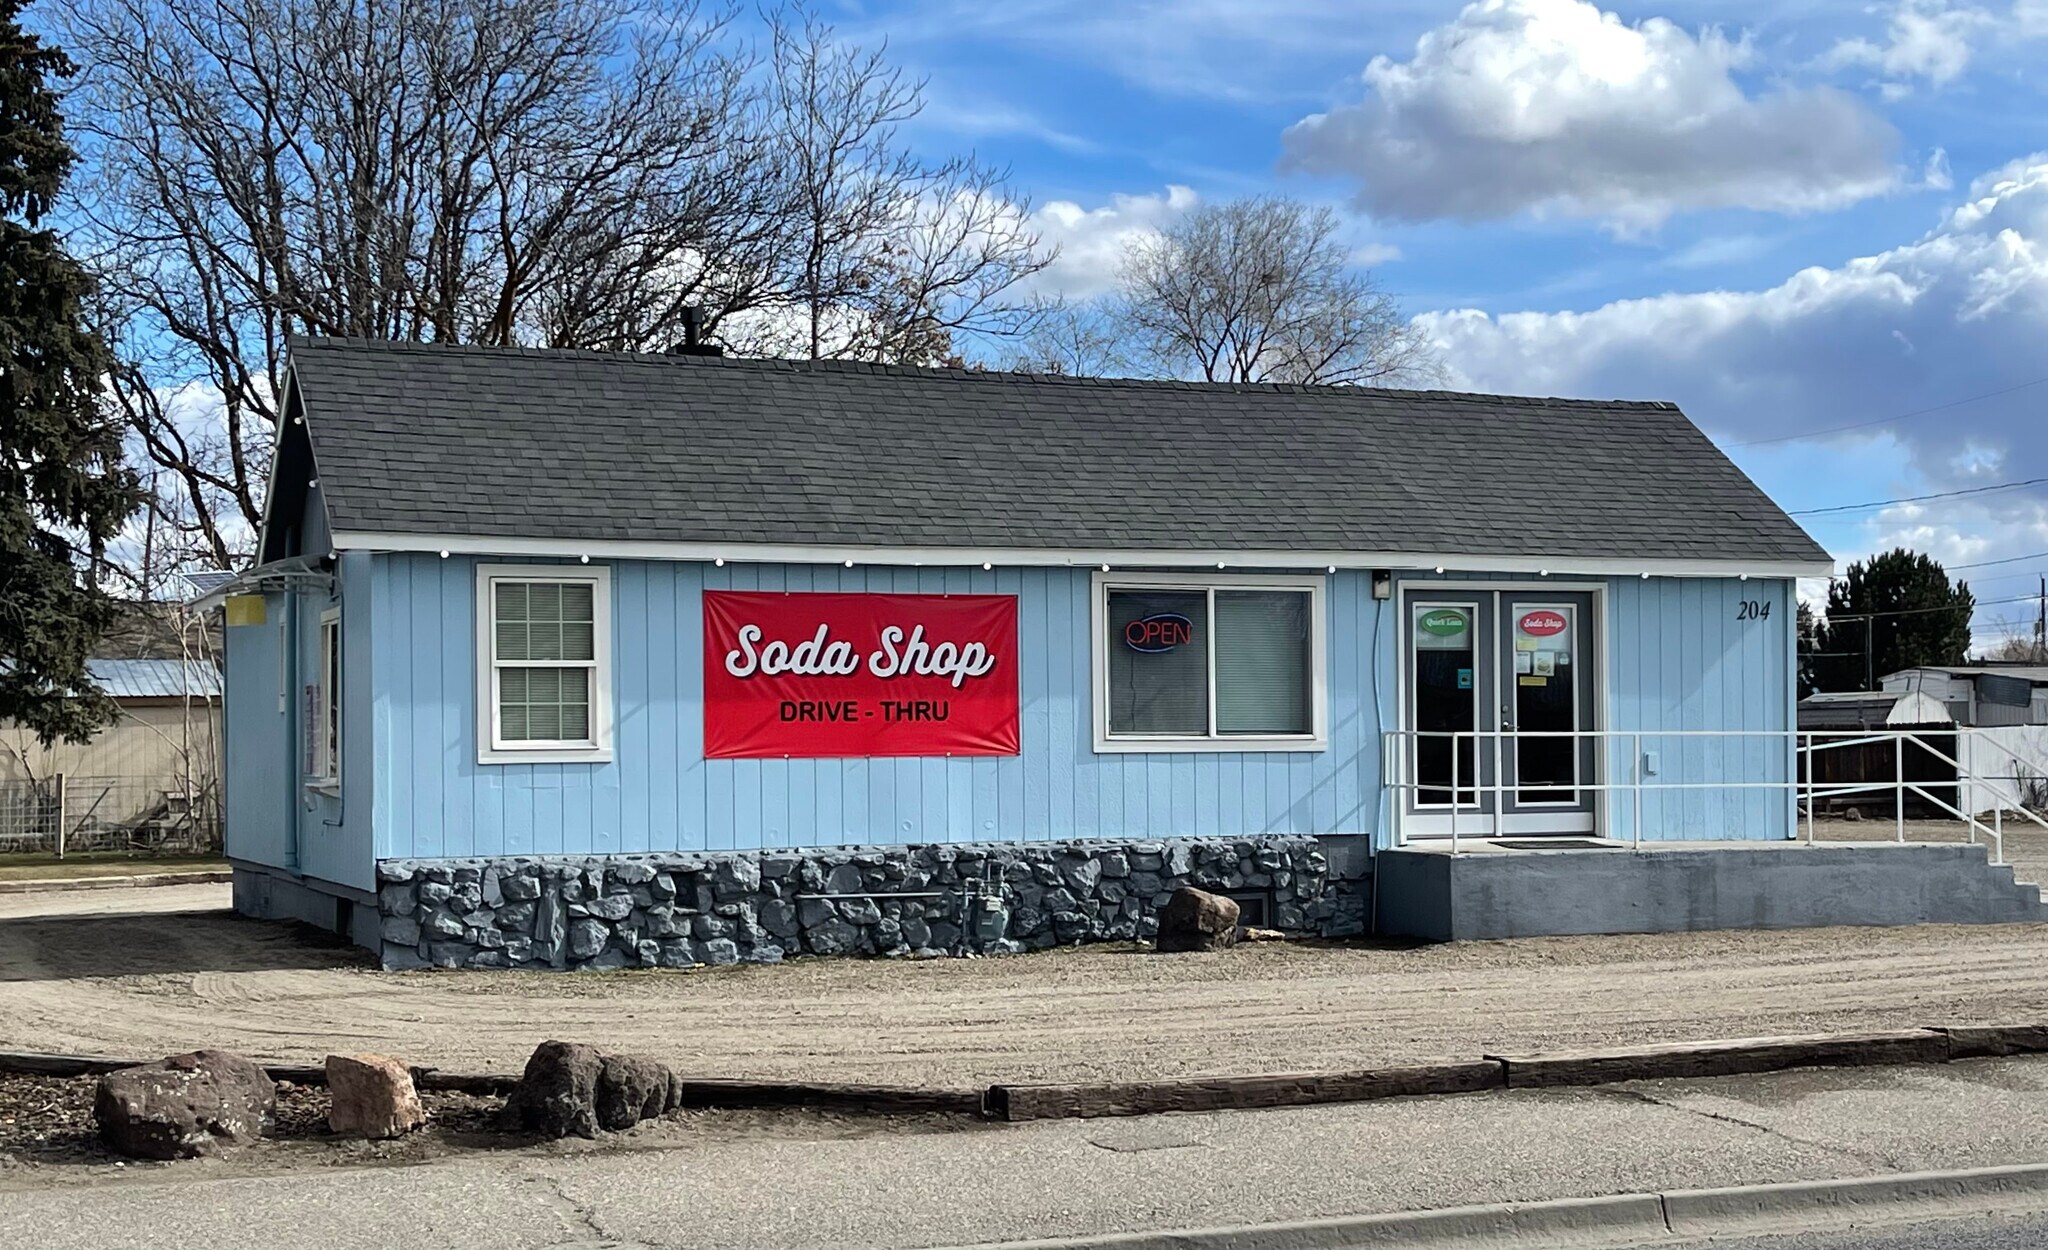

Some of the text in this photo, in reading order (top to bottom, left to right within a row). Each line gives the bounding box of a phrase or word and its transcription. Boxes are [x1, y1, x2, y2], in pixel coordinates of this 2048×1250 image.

[1736, 600, 1771, 620] 204
[1126, 621, 1192, 645] OPEN
[1523, 617, 1563, 629] Soda Shop
[725, 624, 995, 688] Soda Shop
[780, 701, 858, 722] DRIVE
[880, 701, 949, 721] THRU
